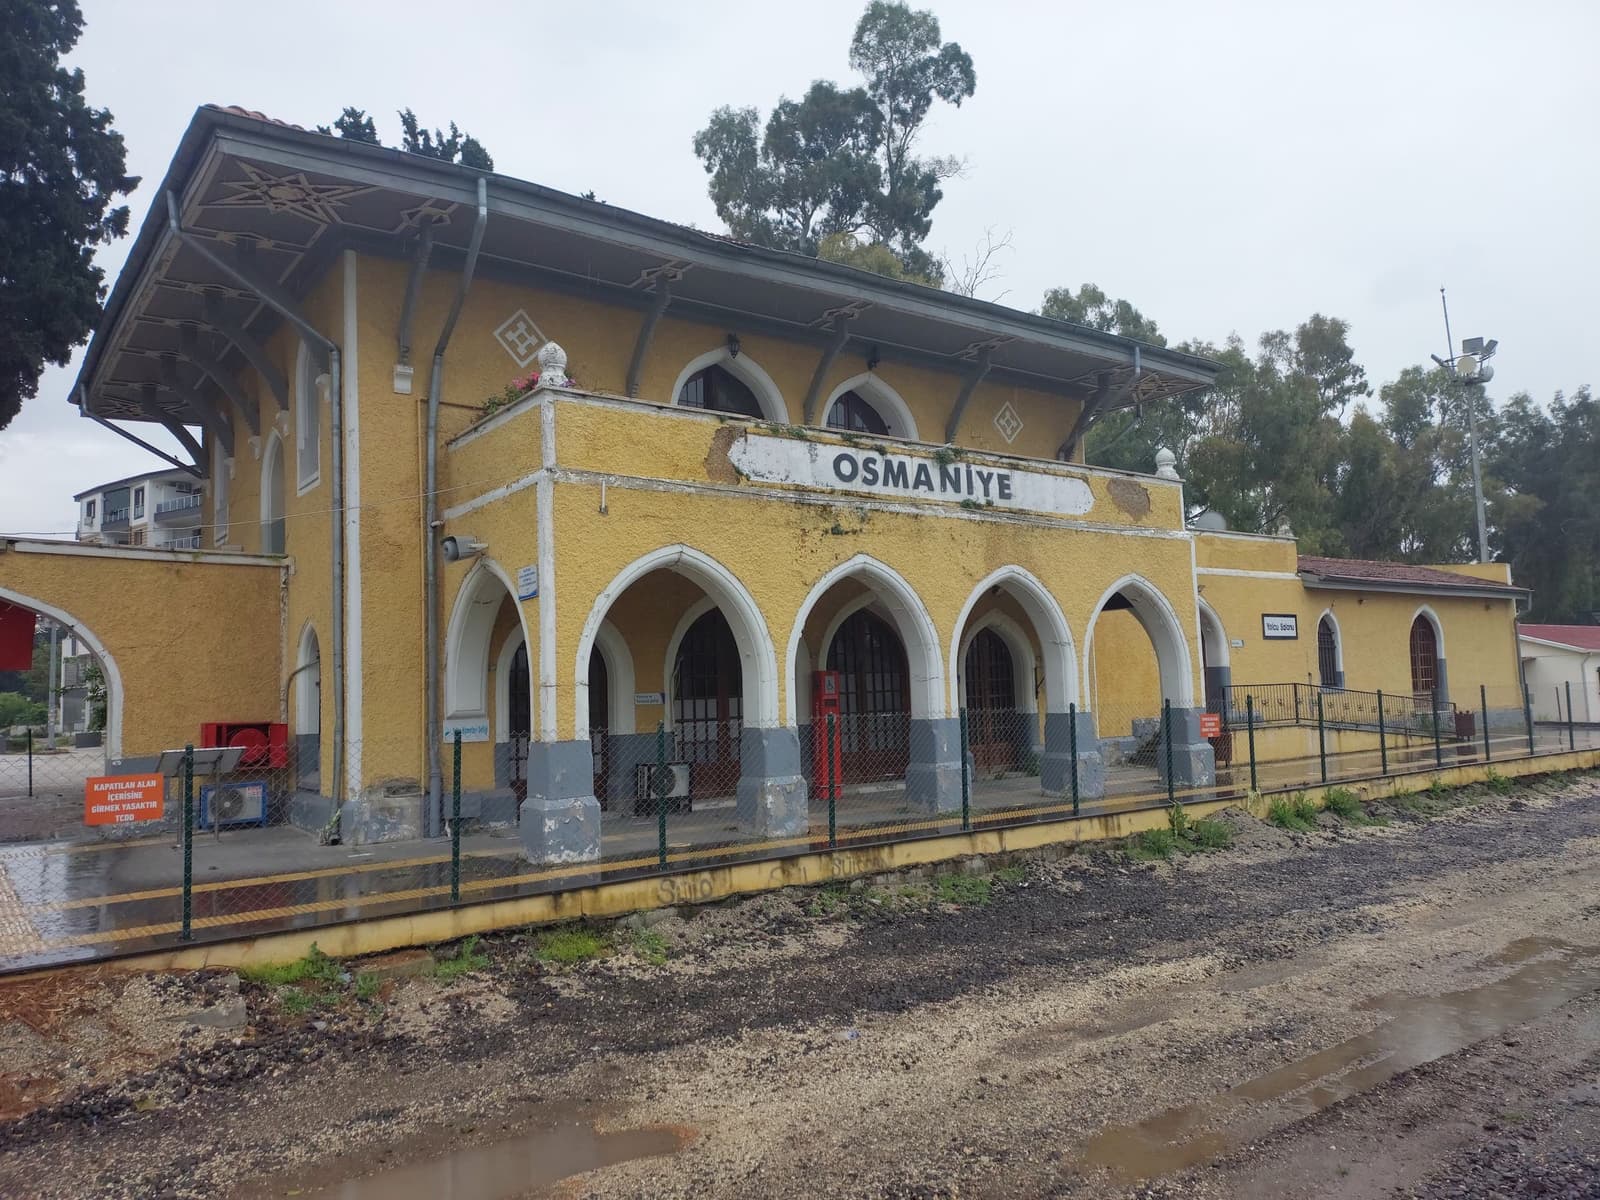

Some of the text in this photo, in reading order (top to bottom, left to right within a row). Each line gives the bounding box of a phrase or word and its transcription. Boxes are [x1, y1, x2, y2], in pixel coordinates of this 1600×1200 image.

[832, 452, 1013, 500] OSMANİYE
[93, 779, 157, 792] KAPATILAN ALAN
[107, 790, 144, 803] İÇERİSİNE
[91, 801, 158, 814] GİRMEK YASAKTIR
[115, 813, 135, 823] TCDD
